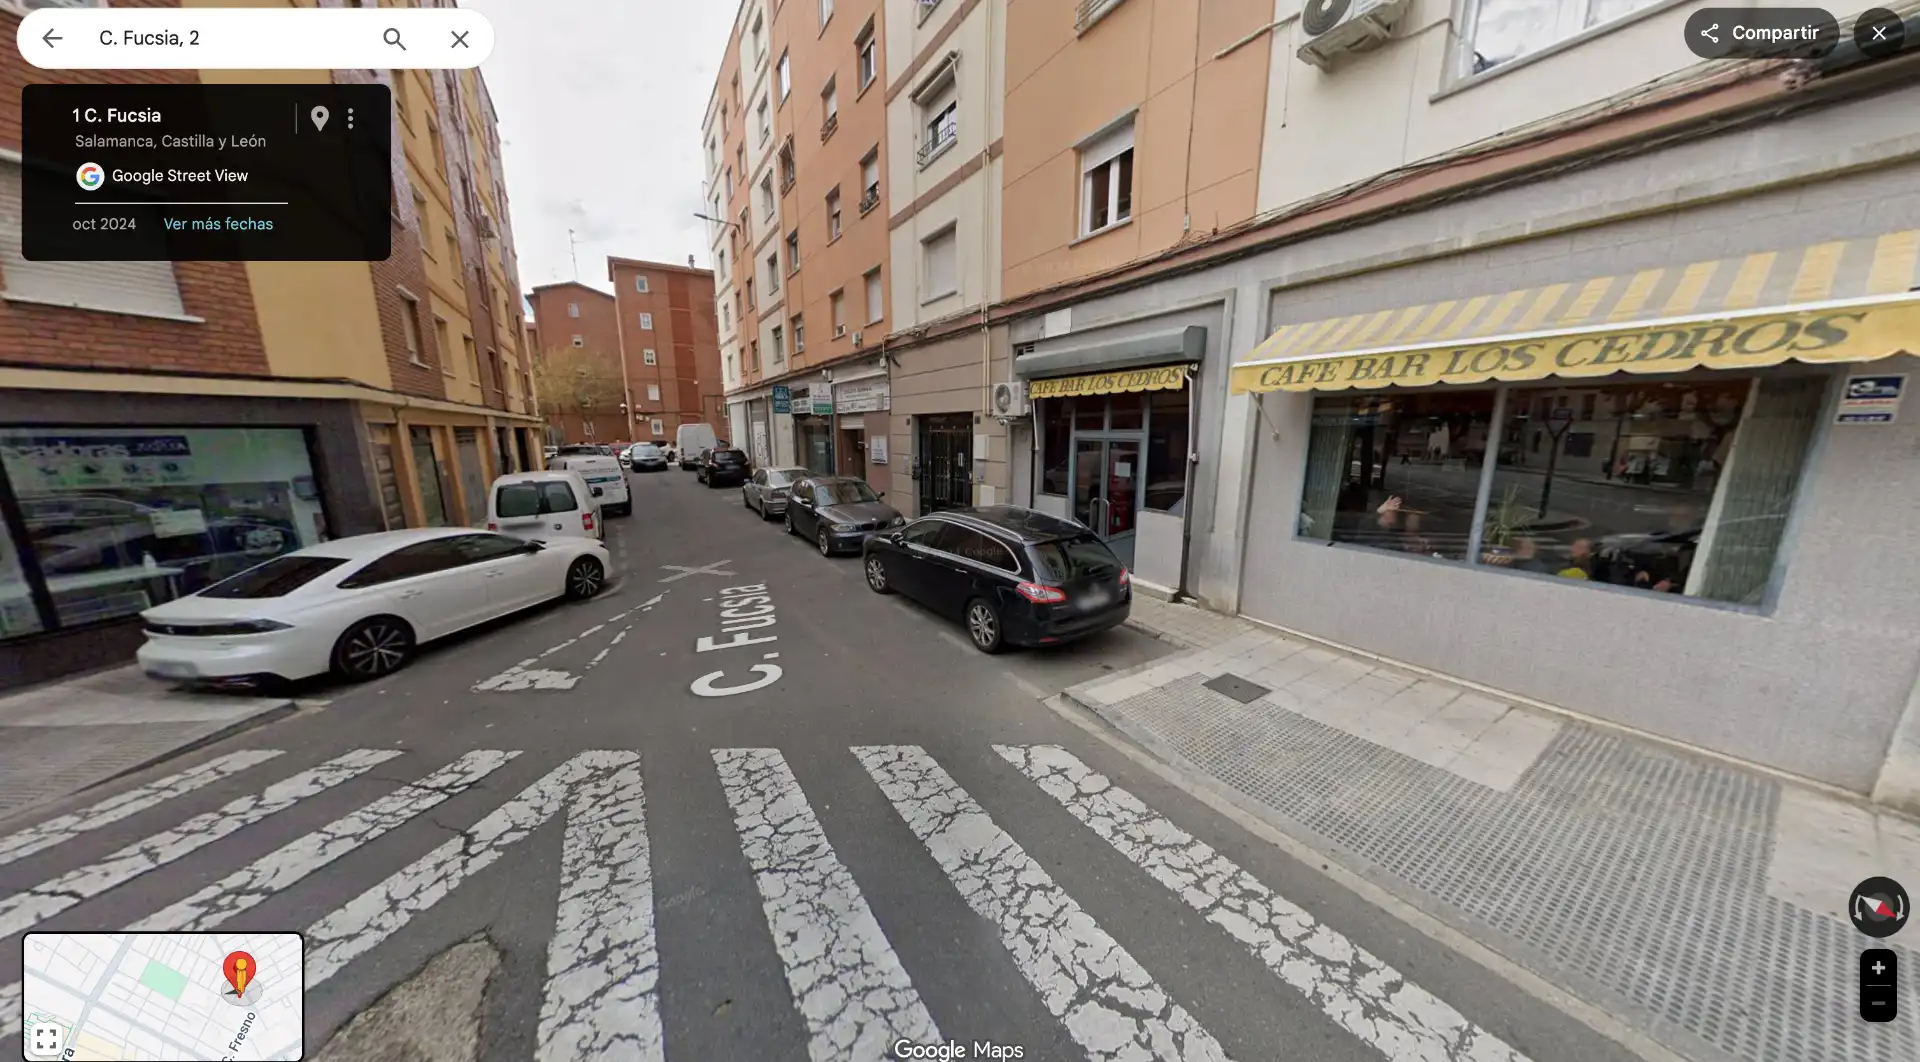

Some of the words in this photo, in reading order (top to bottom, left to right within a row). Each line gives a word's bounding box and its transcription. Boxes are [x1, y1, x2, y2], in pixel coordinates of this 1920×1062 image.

[1260, 360, 1344, 387] CAFE
[1343, 353, 1432, 381] BAR
[1438, 342, 1546, 375] LOS
[1554, 311, 1867, 368] CEDROS
[1030, 379, 1056, 395] CAFE
[1059, 377, 1085, 393] BAR
[1087, 374, 1118, 391] LOS
[1117, 366, 1185, 388] CEDROS
[696, 583, 778, 653] Fucsia
[690, 652, 783, 697] C.
